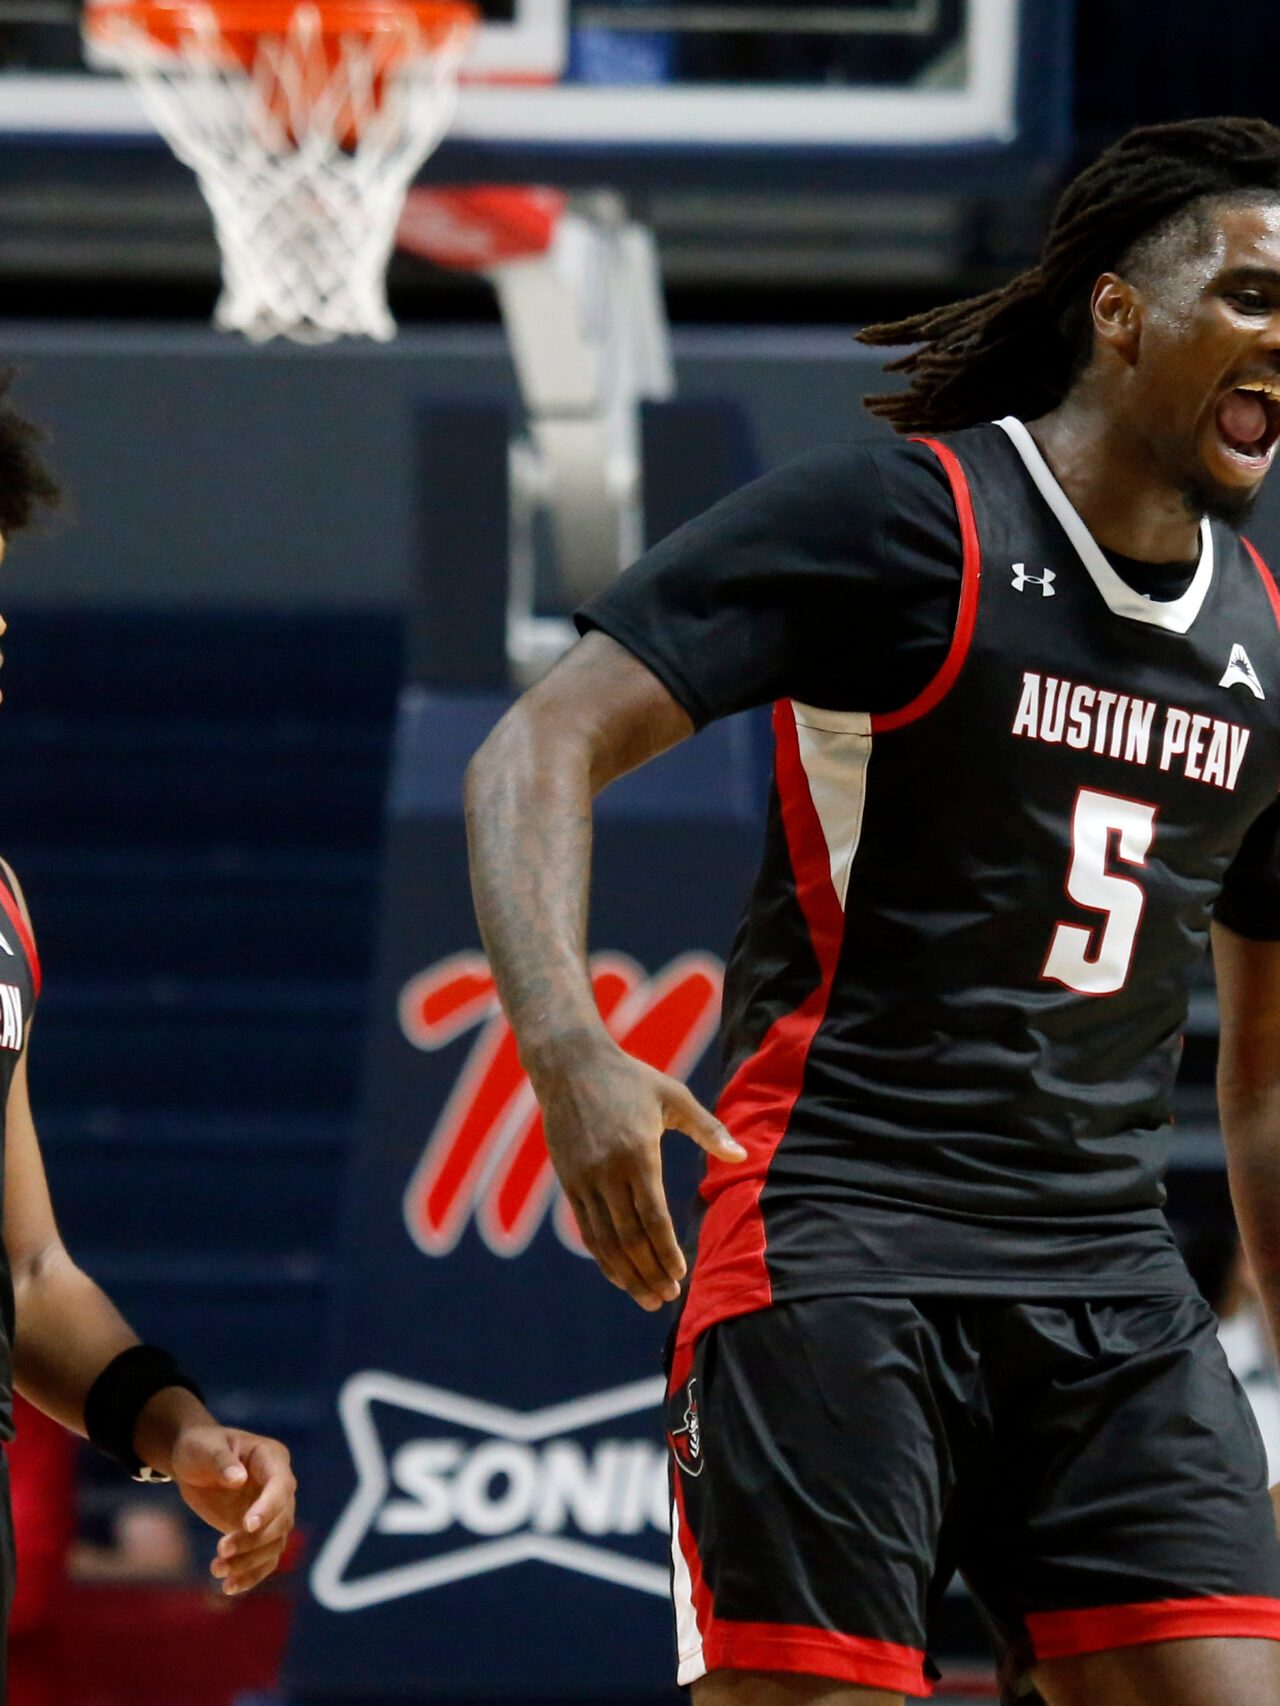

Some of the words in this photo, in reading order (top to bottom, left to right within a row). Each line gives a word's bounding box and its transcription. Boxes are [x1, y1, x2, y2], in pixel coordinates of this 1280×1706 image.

[1011, 671, 1157, 766] AUSTIN
[1159, 707, 1251, 791] PEAY
[1040, 786, 1158, 997] 5
